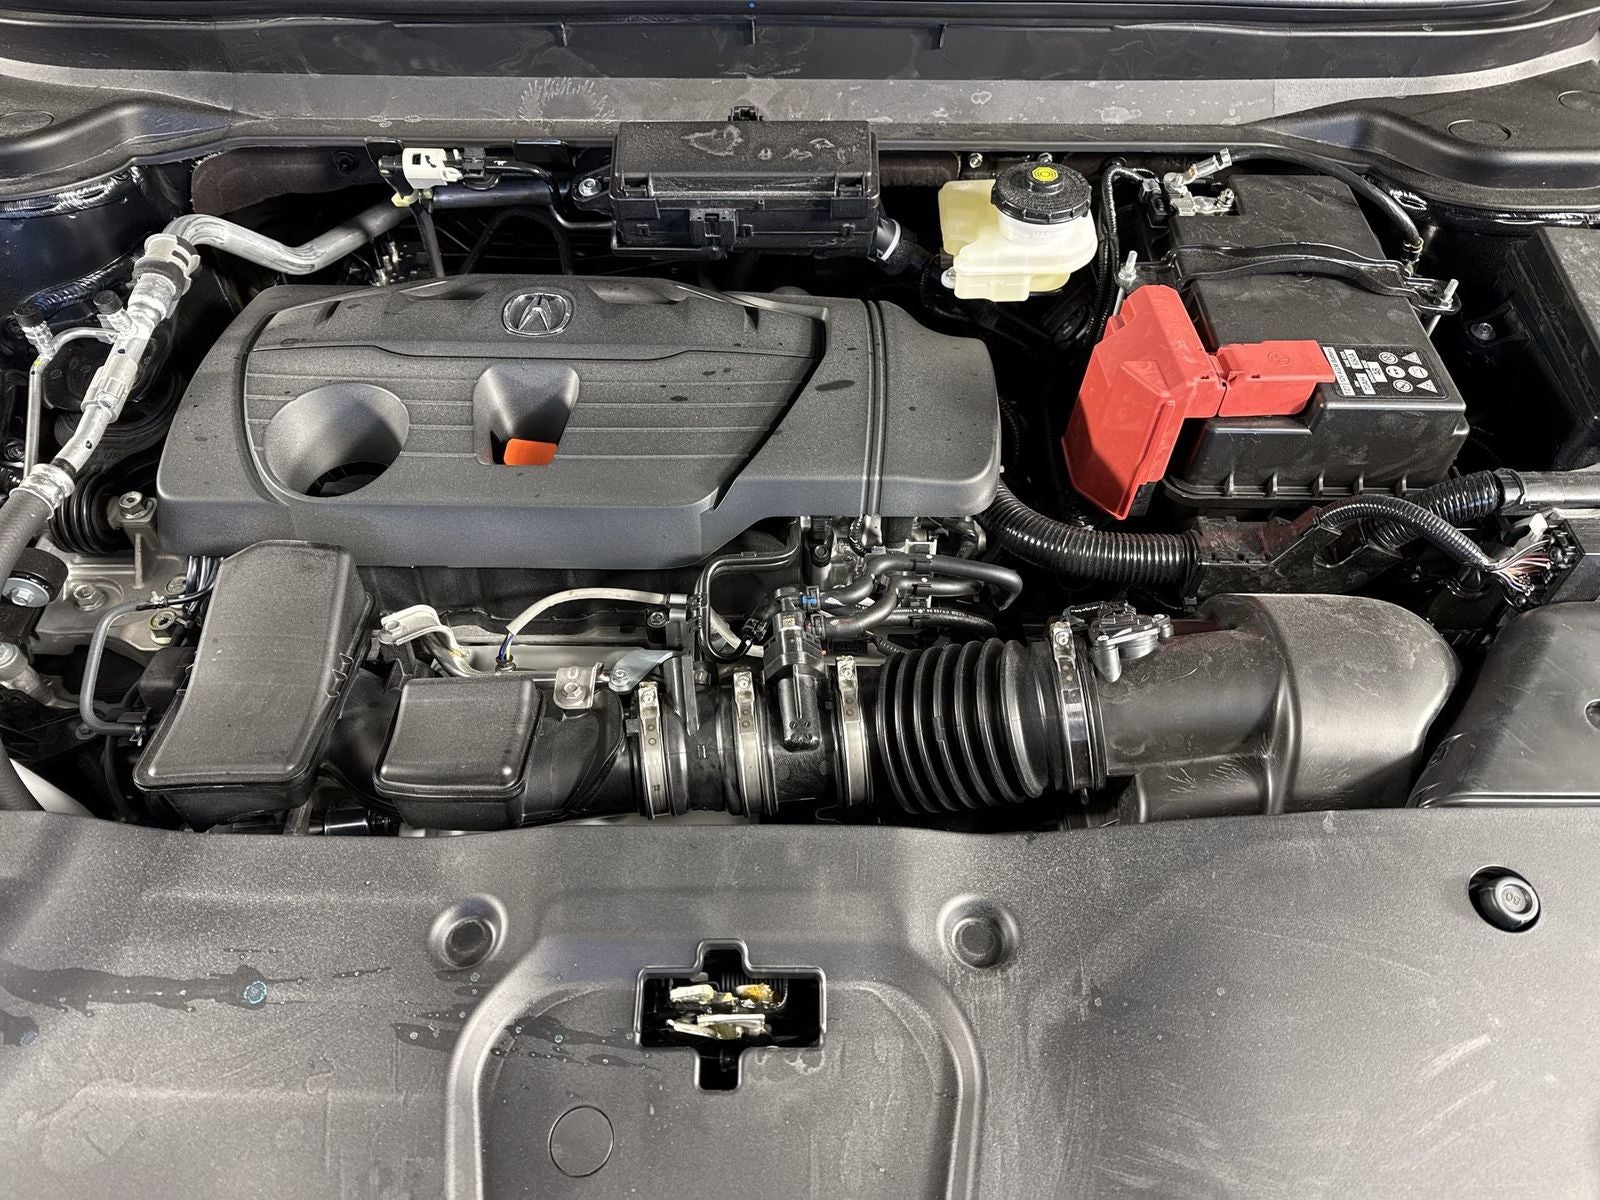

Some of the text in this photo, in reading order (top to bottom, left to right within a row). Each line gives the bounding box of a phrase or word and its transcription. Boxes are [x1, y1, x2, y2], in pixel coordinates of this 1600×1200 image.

[1327, 348, 1338, 363] Battery
[1333, 363, 1342, 376] AGM
[1371, 367, 1381, 376] 48
